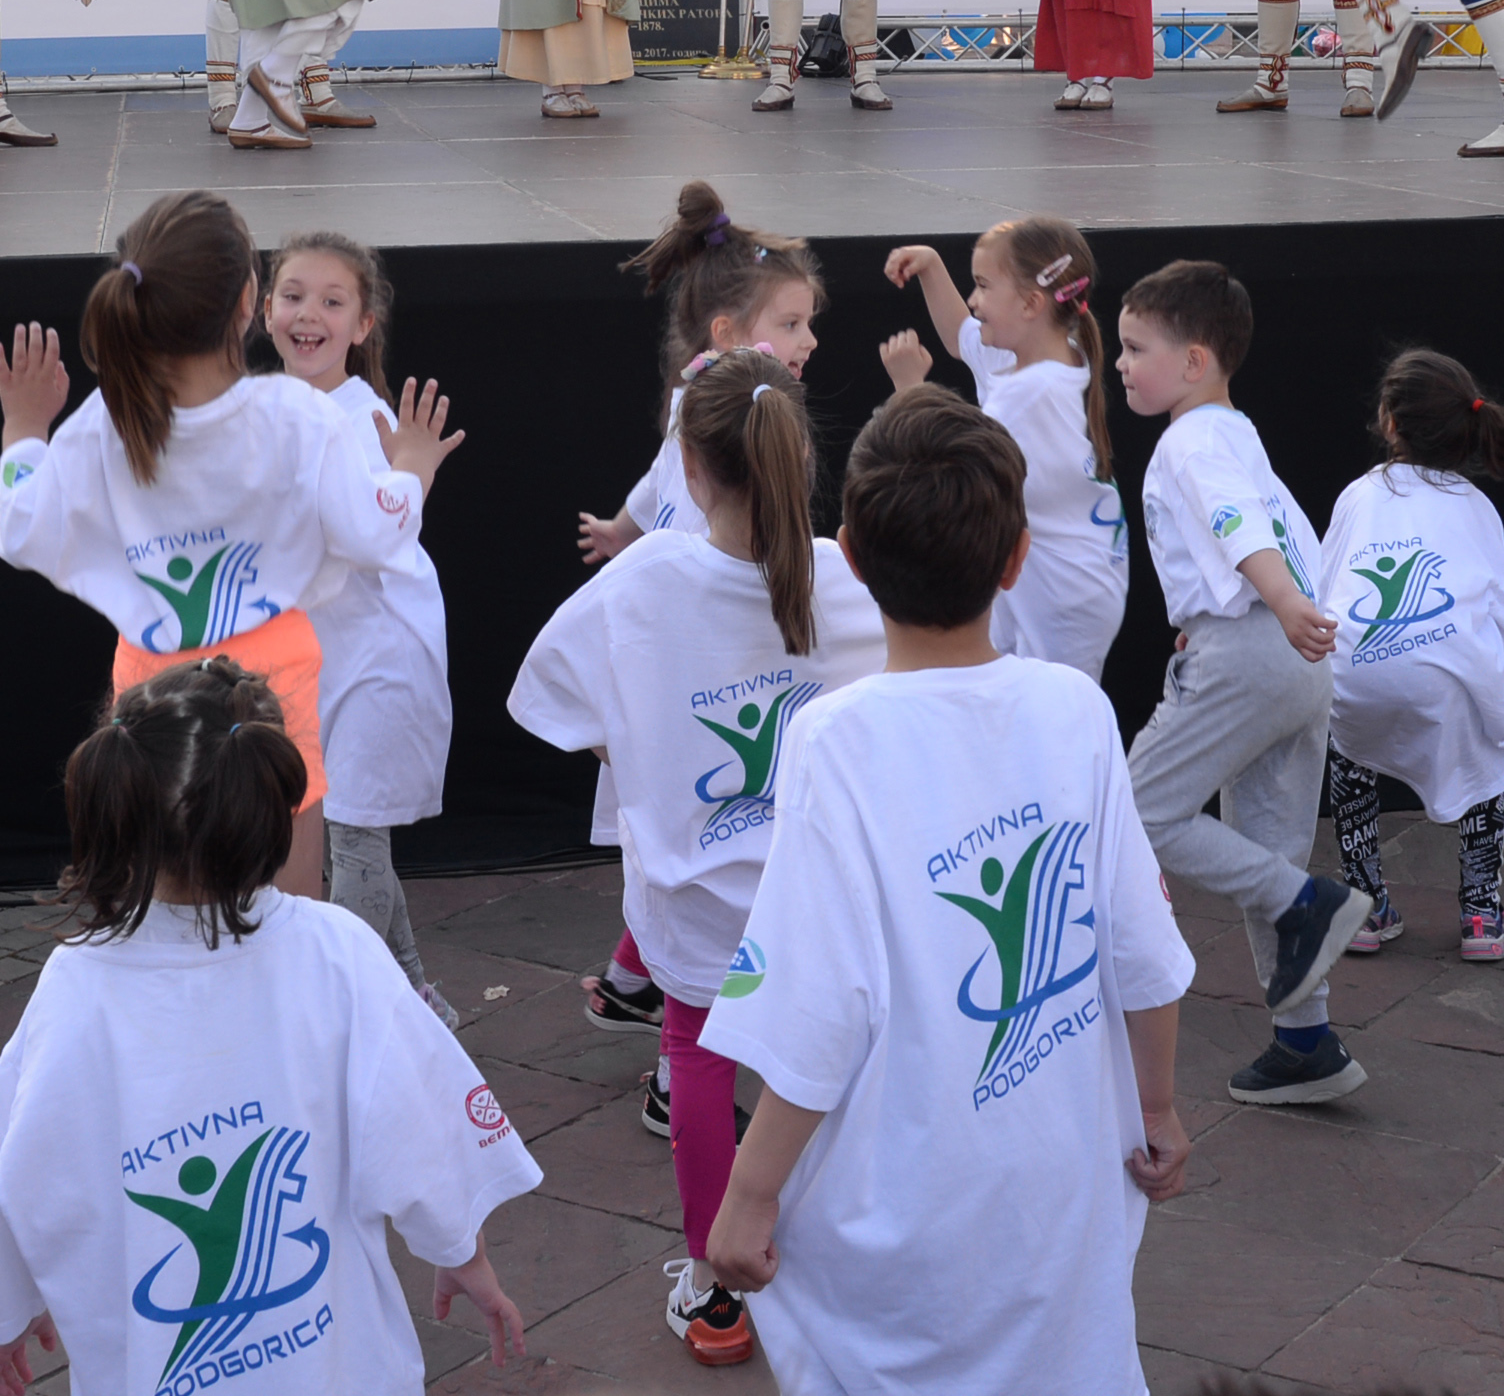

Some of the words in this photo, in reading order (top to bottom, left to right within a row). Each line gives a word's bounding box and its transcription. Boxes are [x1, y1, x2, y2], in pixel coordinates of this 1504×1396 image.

[125, 526, 226, 564] AKTIVNA
[1349, 536, 1423, 566] AKTIVNA
[1351, 622, 1458, 667] PODGORICA
[691, 669, 792, 709] AKTIVNA
[699, 805, 775, 851] PODGO
[927, 802, 1043, 883] AKTIVNA
[121, 1100, 265, 1179] AKTIVNA
